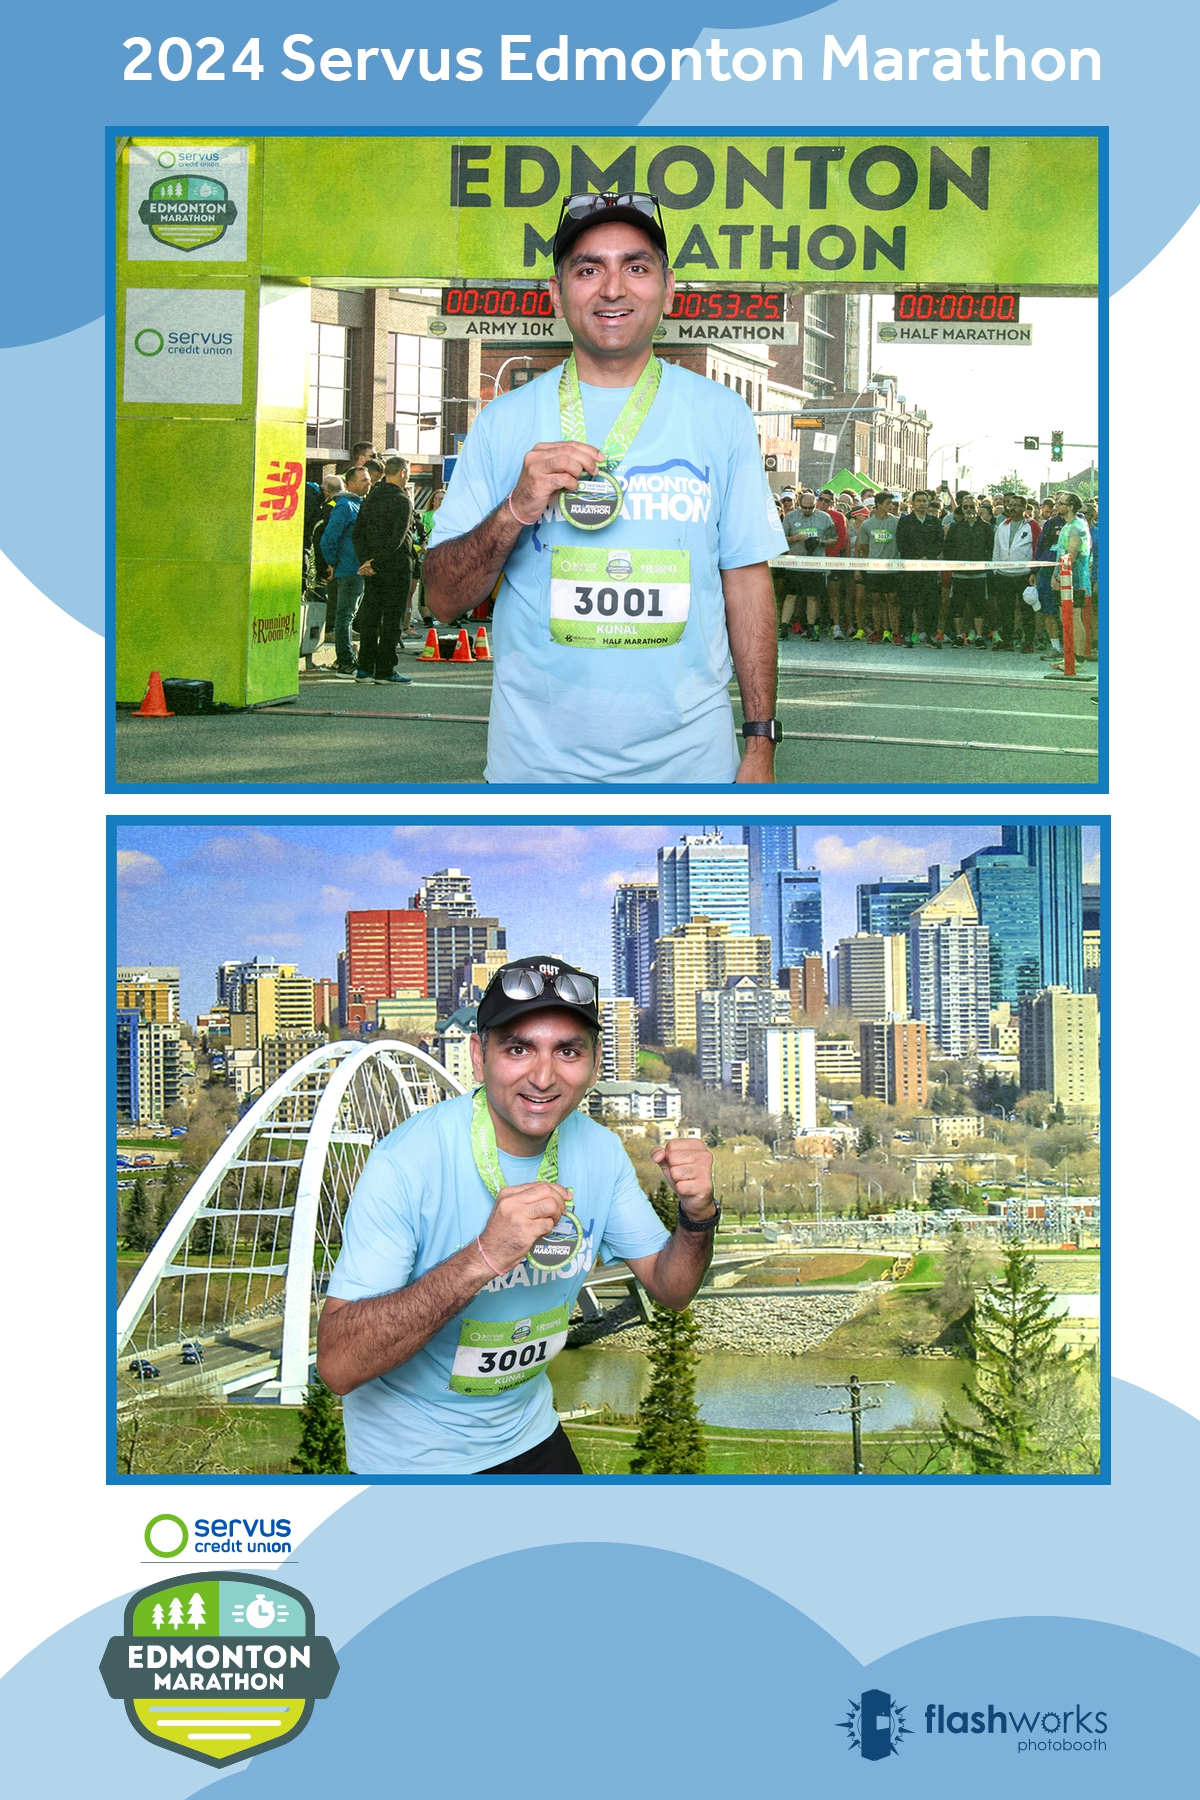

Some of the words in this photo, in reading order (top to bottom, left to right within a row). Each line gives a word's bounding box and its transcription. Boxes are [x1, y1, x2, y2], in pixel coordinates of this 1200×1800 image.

[178, 152, 220, 161] servus
[450, 144, 991, 211] EDMONTON
[149, 202, 227, 214] EDMONTON
[160, 214, 216, 222] MARATHON
[523, 222, 907, 272] MATHON
[465, 321, 518, 336] ARMY
[521, 322, 555, 337] 10K
[678, 325, 785, 340] MARATHON
[900, 328, 939, 340] HALF
[943, 329, 1031, 341] MARATHON
[168, 332, 233, 345] servus
[168, 345, 200, 355] credit
[203, 347, 233, 355] union
[606, 474, 712, 498] DMONTON
[570, 506, 611, 514] MARATHON
[574, 586, 663, 617] 3001
[257, 613, 291, 643] Running
[596, 624, 639, 634] KUNAL
[627, 637, 668, 645] MARATHON
[532, 1247, 571, 1256] MARATHON
[477, 1341, 548, 1374] 3001
[494, 1371, 526, 1384] KUNAL
